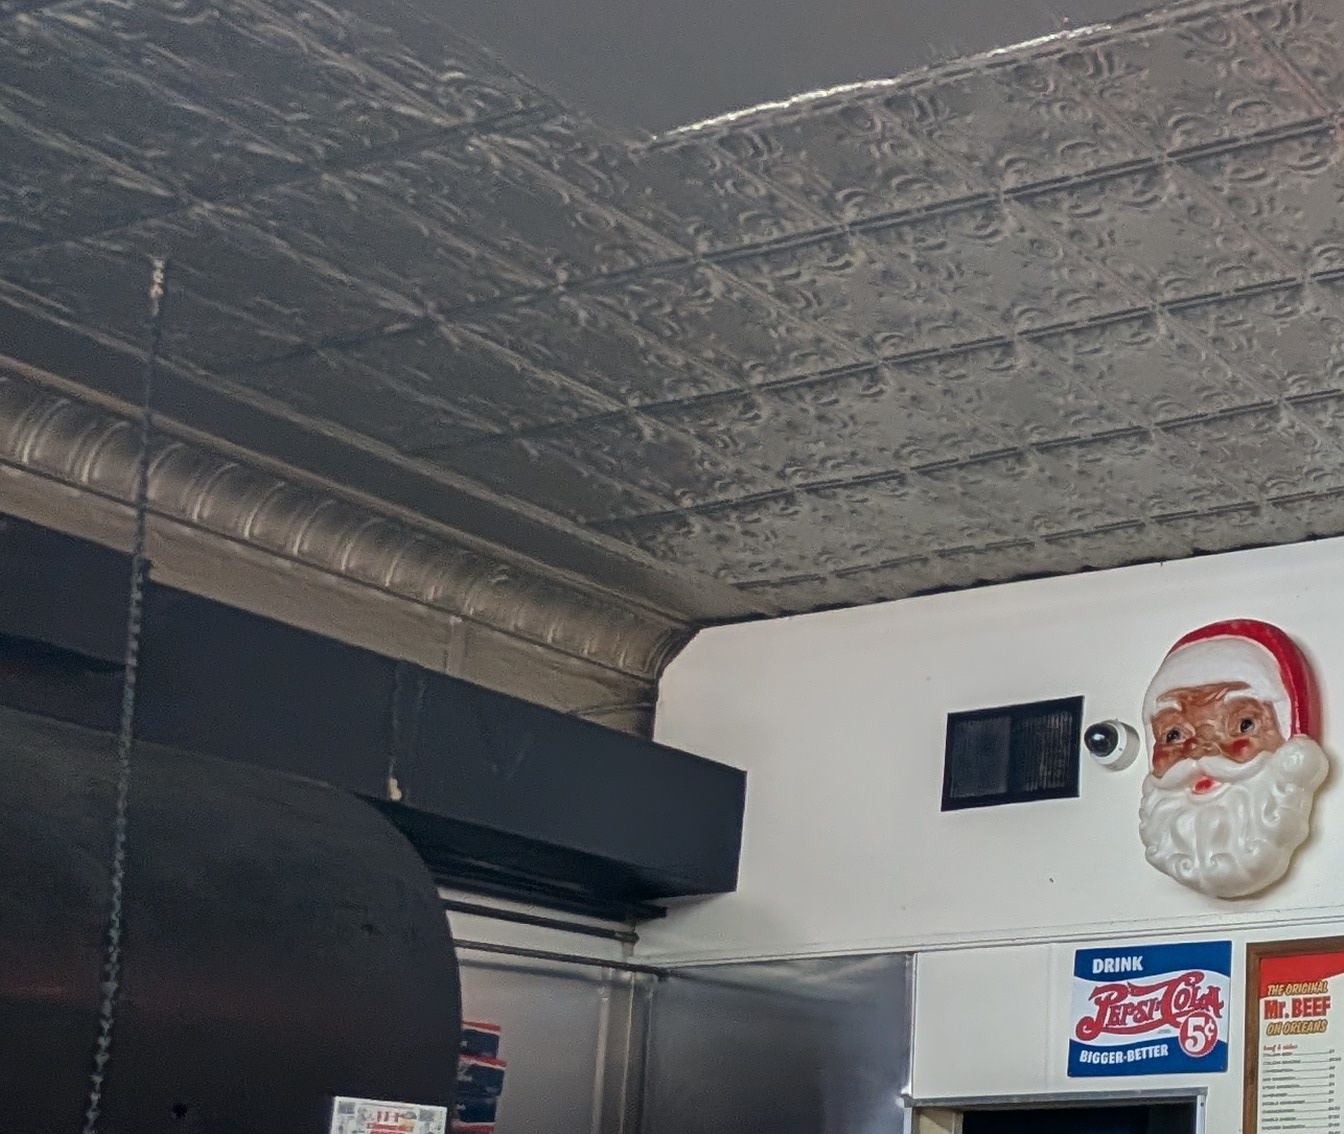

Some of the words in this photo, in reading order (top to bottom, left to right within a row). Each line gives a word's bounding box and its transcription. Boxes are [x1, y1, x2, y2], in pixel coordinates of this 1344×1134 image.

[1092, 955, 1144, 975] DRINK
[1267, 983, 1284, 996] THE
[1285, 979, 1329, 995] ORIGINAL
[1263, 999, 1290, 1020] Mr.
[1291, 996, 1331, 1018] BEEF
[1266, 1022, 1282, 1036] ON
[1282, 1019, 1328, 1035] ORLEANS
